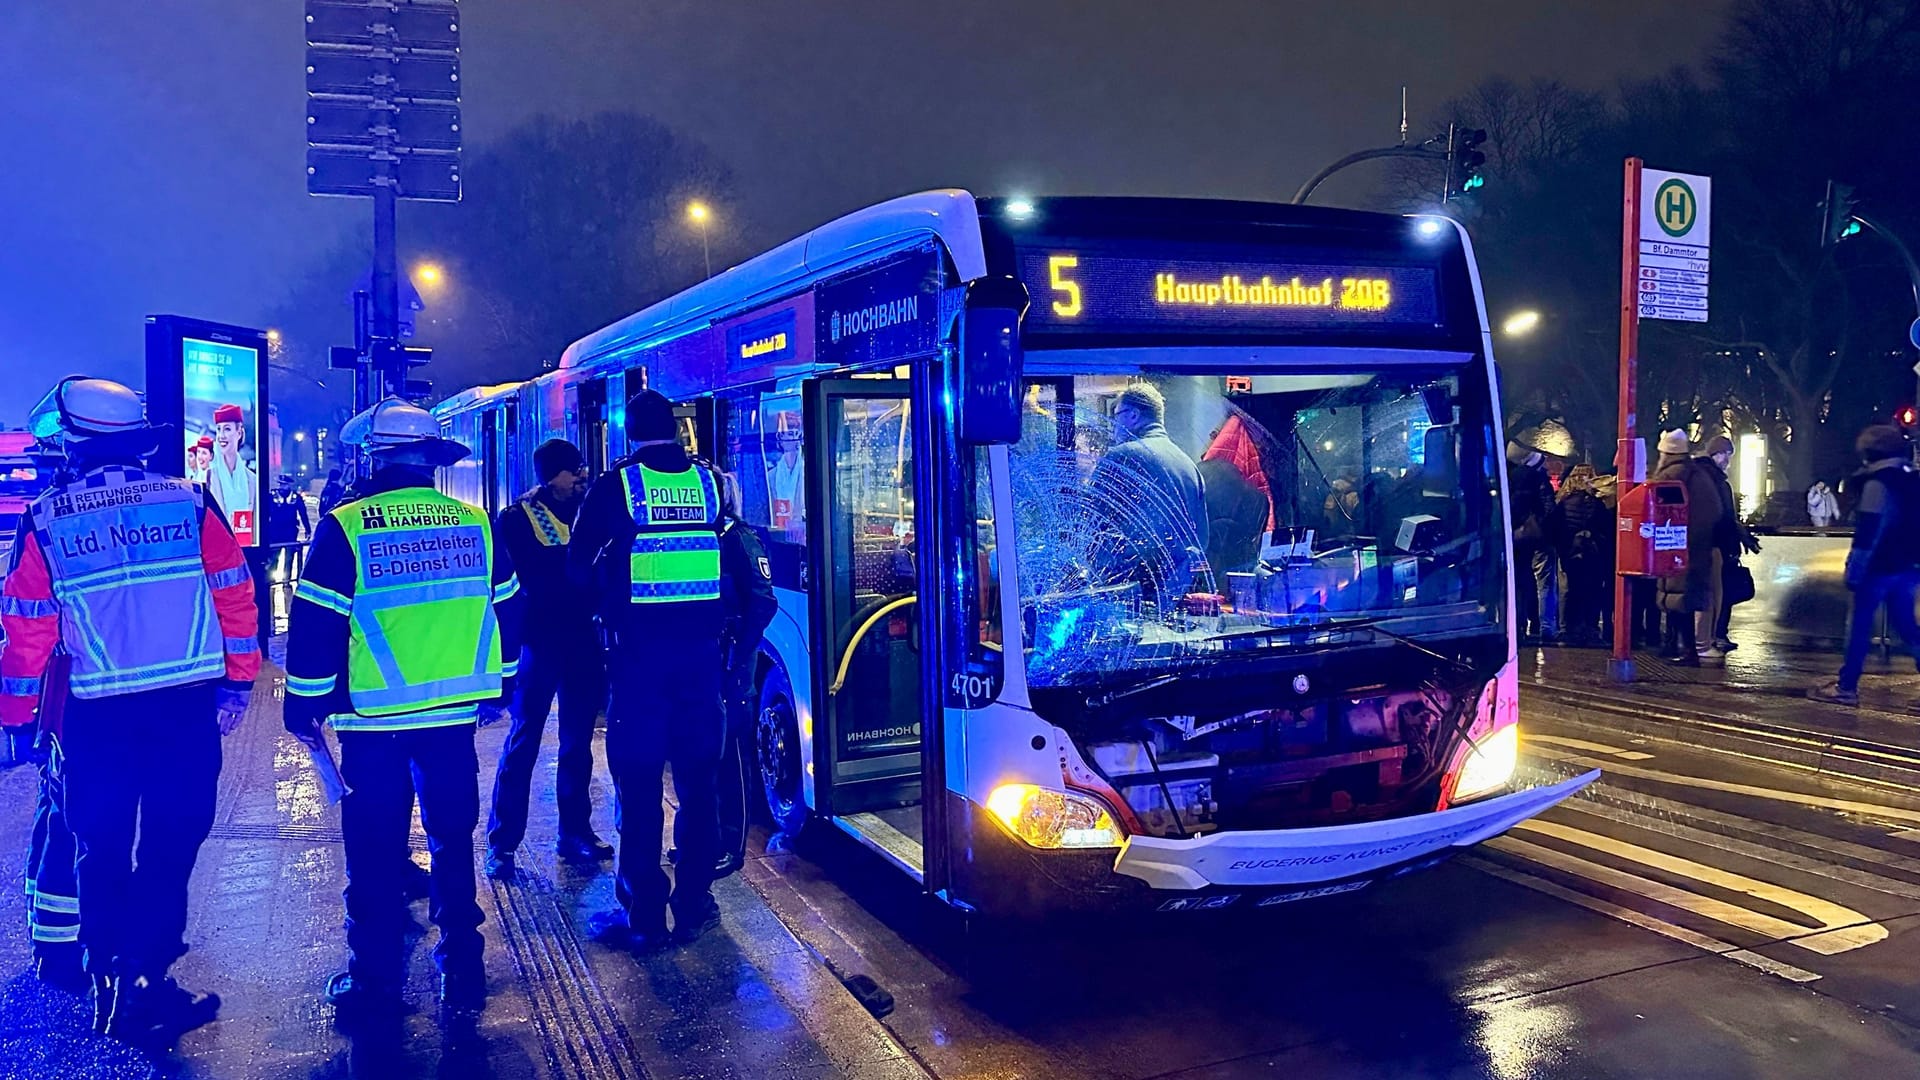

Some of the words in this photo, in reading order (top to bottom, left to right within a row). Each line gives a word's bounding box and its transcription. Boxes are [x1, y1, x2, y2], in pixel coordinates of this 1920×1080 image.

[1666, 191, 1686, 224] H
[1664, 245, 1698, 257] Dammtor
[1049, 256, 1081, 317] 5
[1156, 273, 1332, 306] Hauptbahnhof
[1341, 278, 1390, 309] ZOB
[843, 295, 918, 337] HOCHBAHN
[75, 482, 183, 503] RETTUNGSDIENST
[77, 494, 142, 513] HAMBURG
[650, 488, 702, 504] POLIZEI
[387, 503, 474, 516] FEUERWEHR
[391, 515, 460, 527] HAMBURG
[653, 507, 703, 520] VU-TEAM
[60, 530, 106, 558] Ltd.
[110, 518, 193, 548] Notarzt
[369, 534, 478, 558] Einsatzleiter
[369, 556, 450, 578] B-Dienst
[453, 552, 483, 569] 10/1
[952, 673, 990, 699] 4701
[1229, 854, 1342, 870] BUCERIUS
[1343, 841, 1416, 861] KUNST
